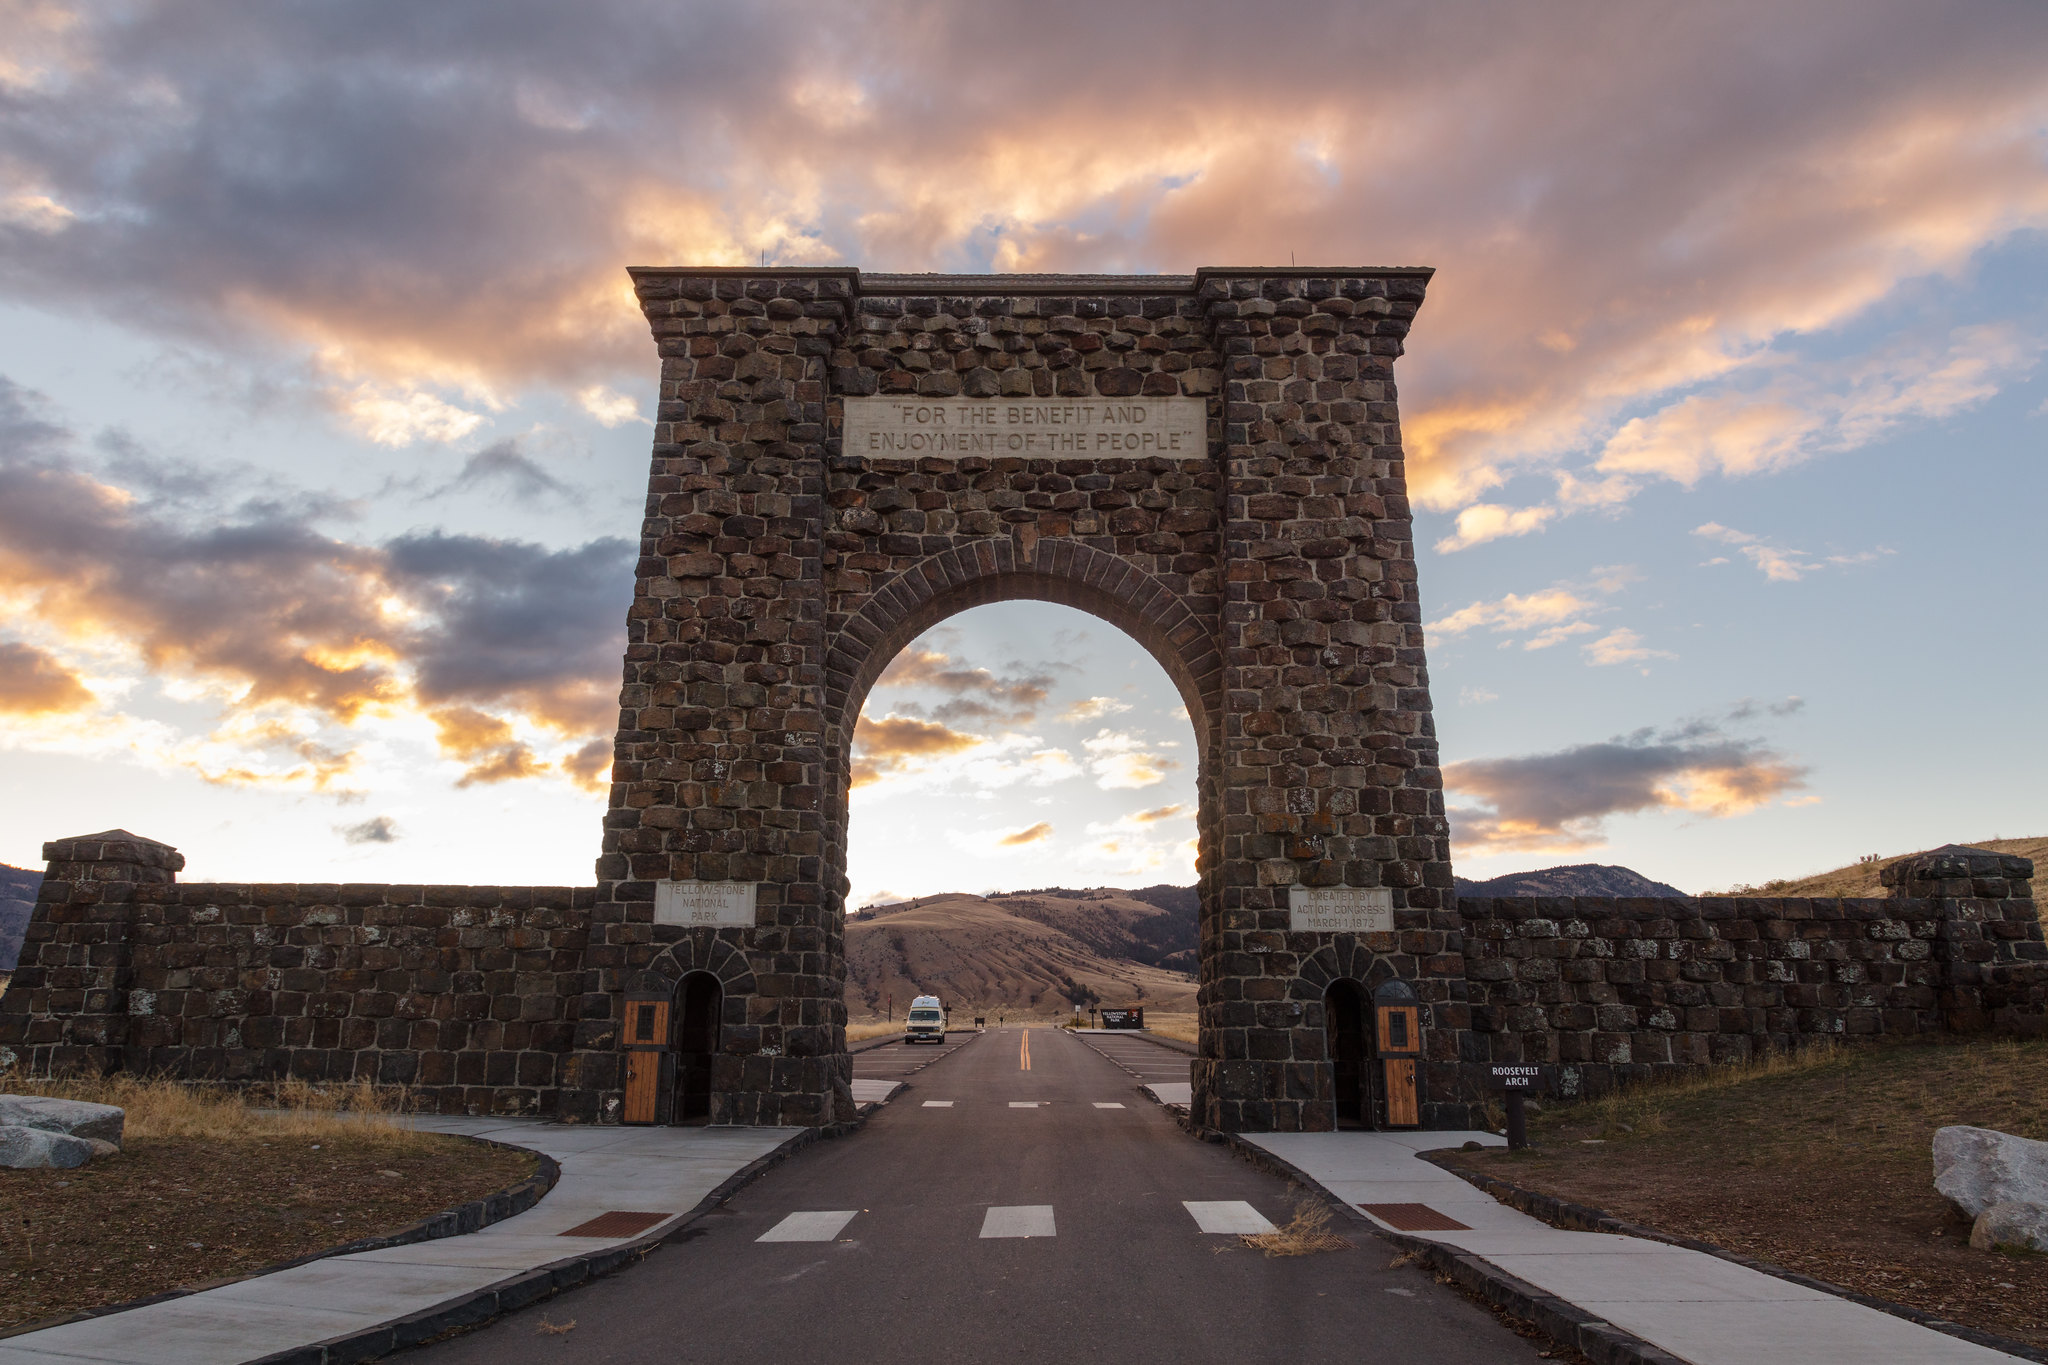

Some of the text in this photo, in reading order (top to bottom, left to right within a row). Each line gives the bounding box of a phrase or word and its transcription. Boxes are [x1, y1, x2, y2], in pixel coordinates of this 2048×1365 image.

[957, 406, 998, 425] THE
[1007, 406, 1095, 425] BENEFIT
[1102, 406, 1147, 424] AND
[870, 432, 998, 451] ENJOYMENT
[1007, 433, 1036, 451] OF
[1046, 433, 1091, 451] THE
[669, 885, 745, 895] YELLOWSTONE
[1309, 891, 1372, 901] CREATED BY
[682, 898, 729, 908] NATIONAL
[1297, 904, 1385, 914] ACT OF CONGRESS
[691, 911, 718, 921] PARK
[1308, 918, 1341, 928] MARCH
[1492, 1066, 1539, 1075] ROOSEVELT
[1505, 1077, 1529, 1086] ARCH
